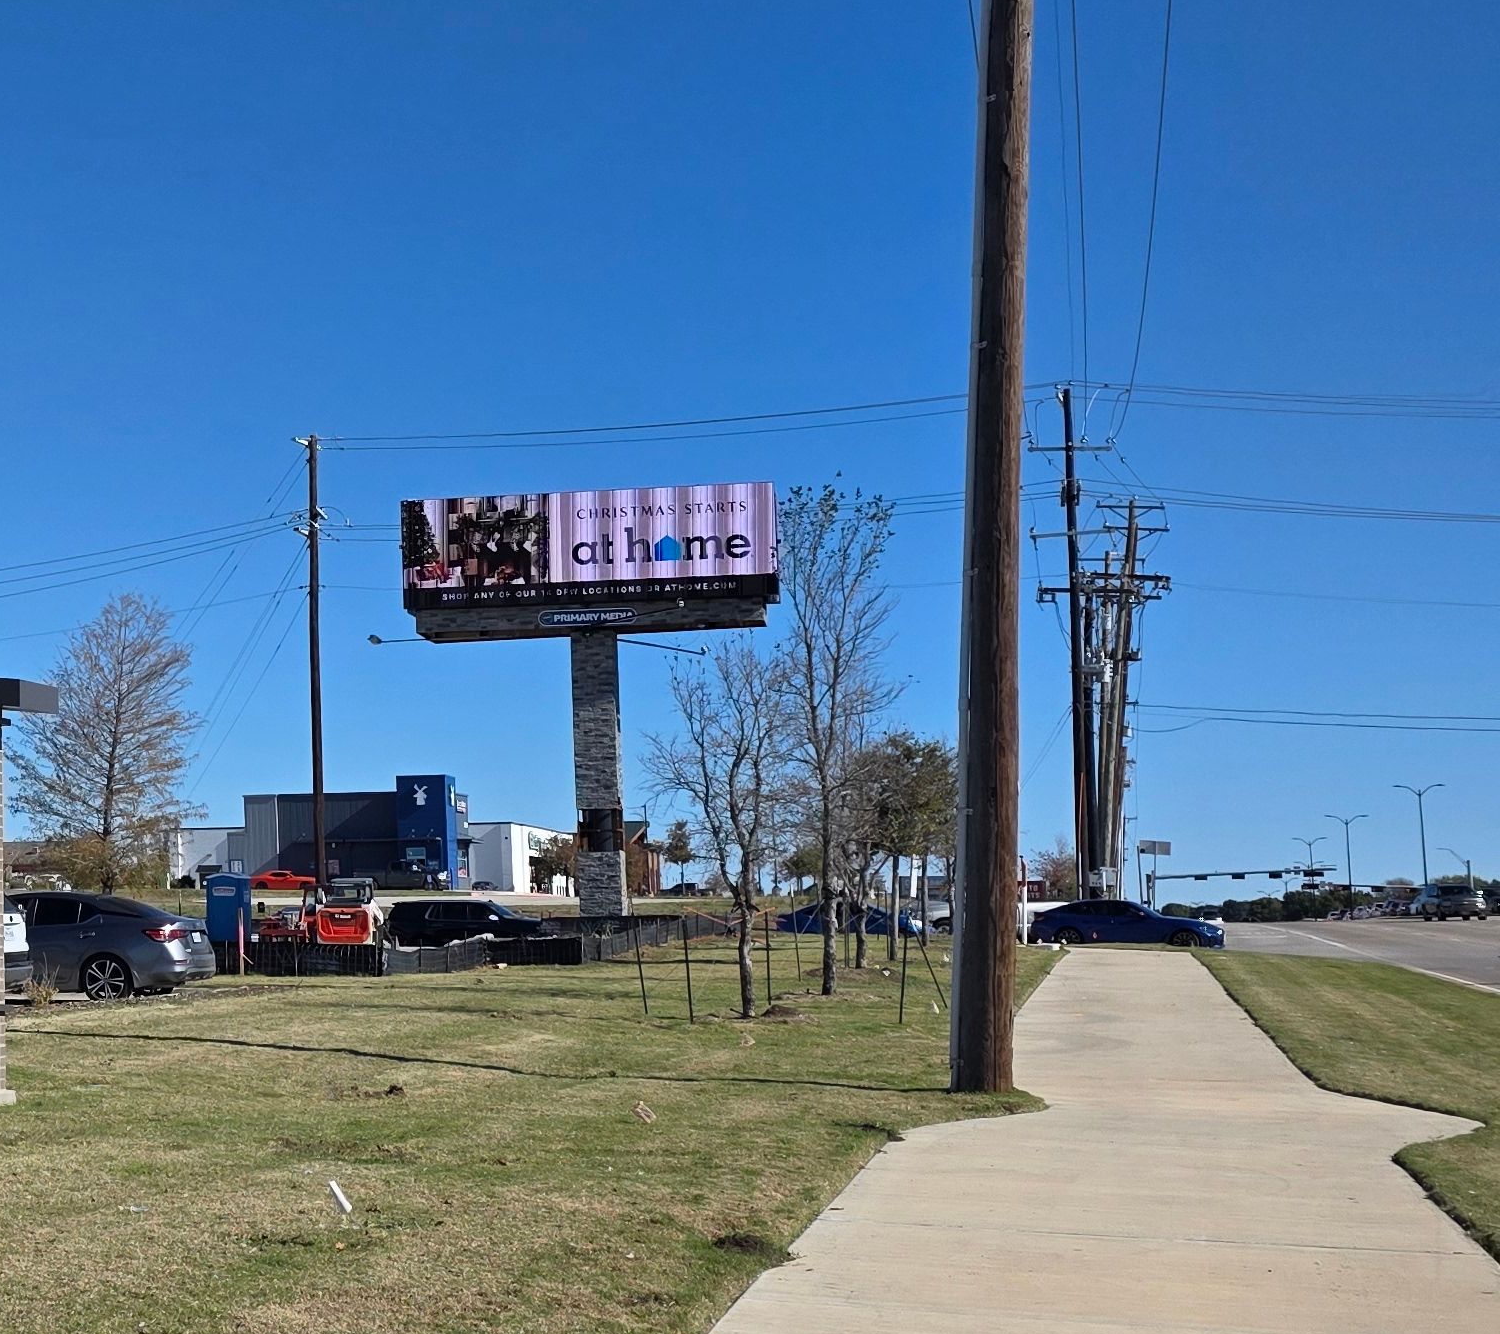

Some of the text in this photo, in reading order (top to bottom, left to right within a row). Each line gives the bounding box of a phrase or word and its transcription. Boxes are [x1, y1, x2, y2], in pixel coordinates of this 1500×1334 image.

[576, 500, 747, 520] CHRISTMAS STARTS
[473, 591, 495, 599] ANY
[515, 589, 537, 598] OUR
[555, 587, 578, 596] DFW
[582, 584, 642, 595] LOCATIONS
[664, 581, 738, 592] ATHOME.COM
[553, 611, 633, 623] PRIMARY MEDIA
